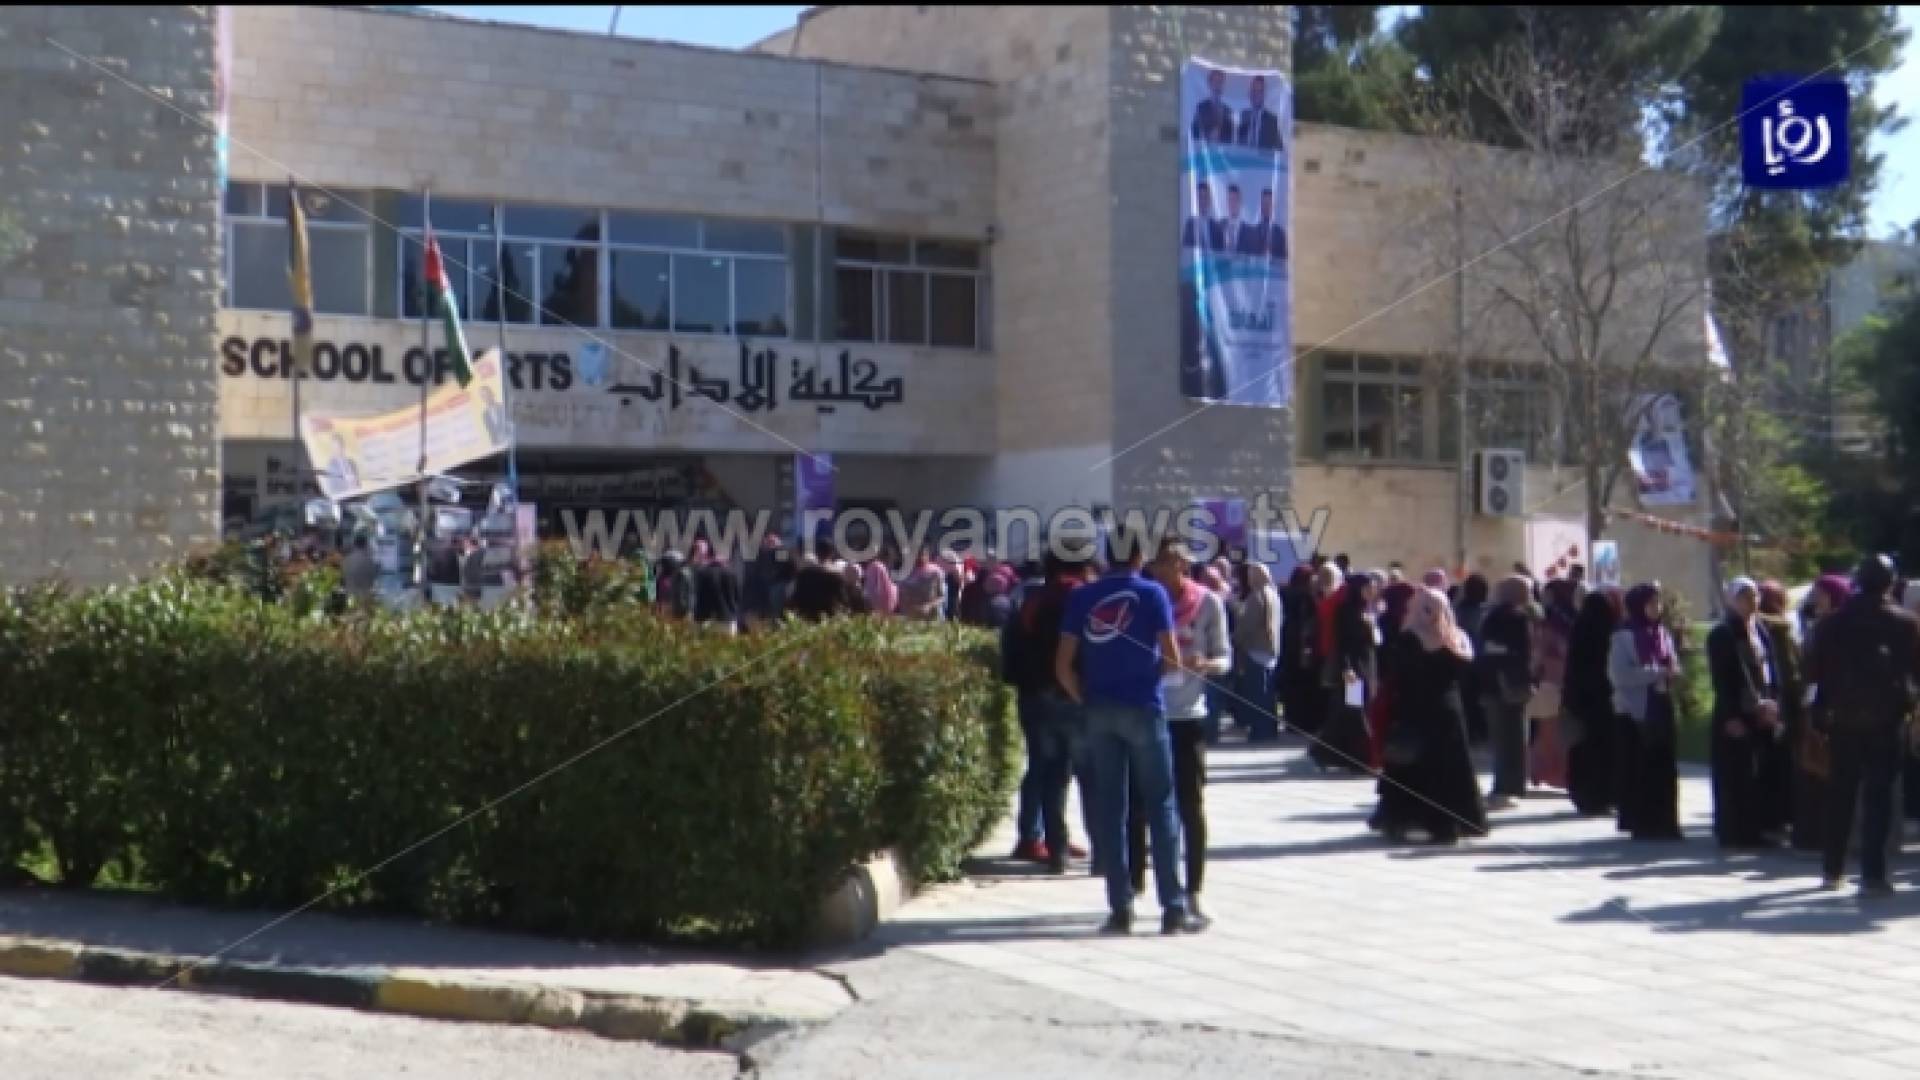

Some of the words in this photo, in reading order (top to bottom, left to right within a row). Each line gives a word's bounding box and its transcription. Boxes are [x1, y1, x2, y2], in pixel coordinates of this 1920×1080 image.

[221, 336, 395, 385] SCHOOL
[402, 346, 458, 387] OF
[472, 347, 573, 391] RTS
[790, 349, 904, 414] كلية
